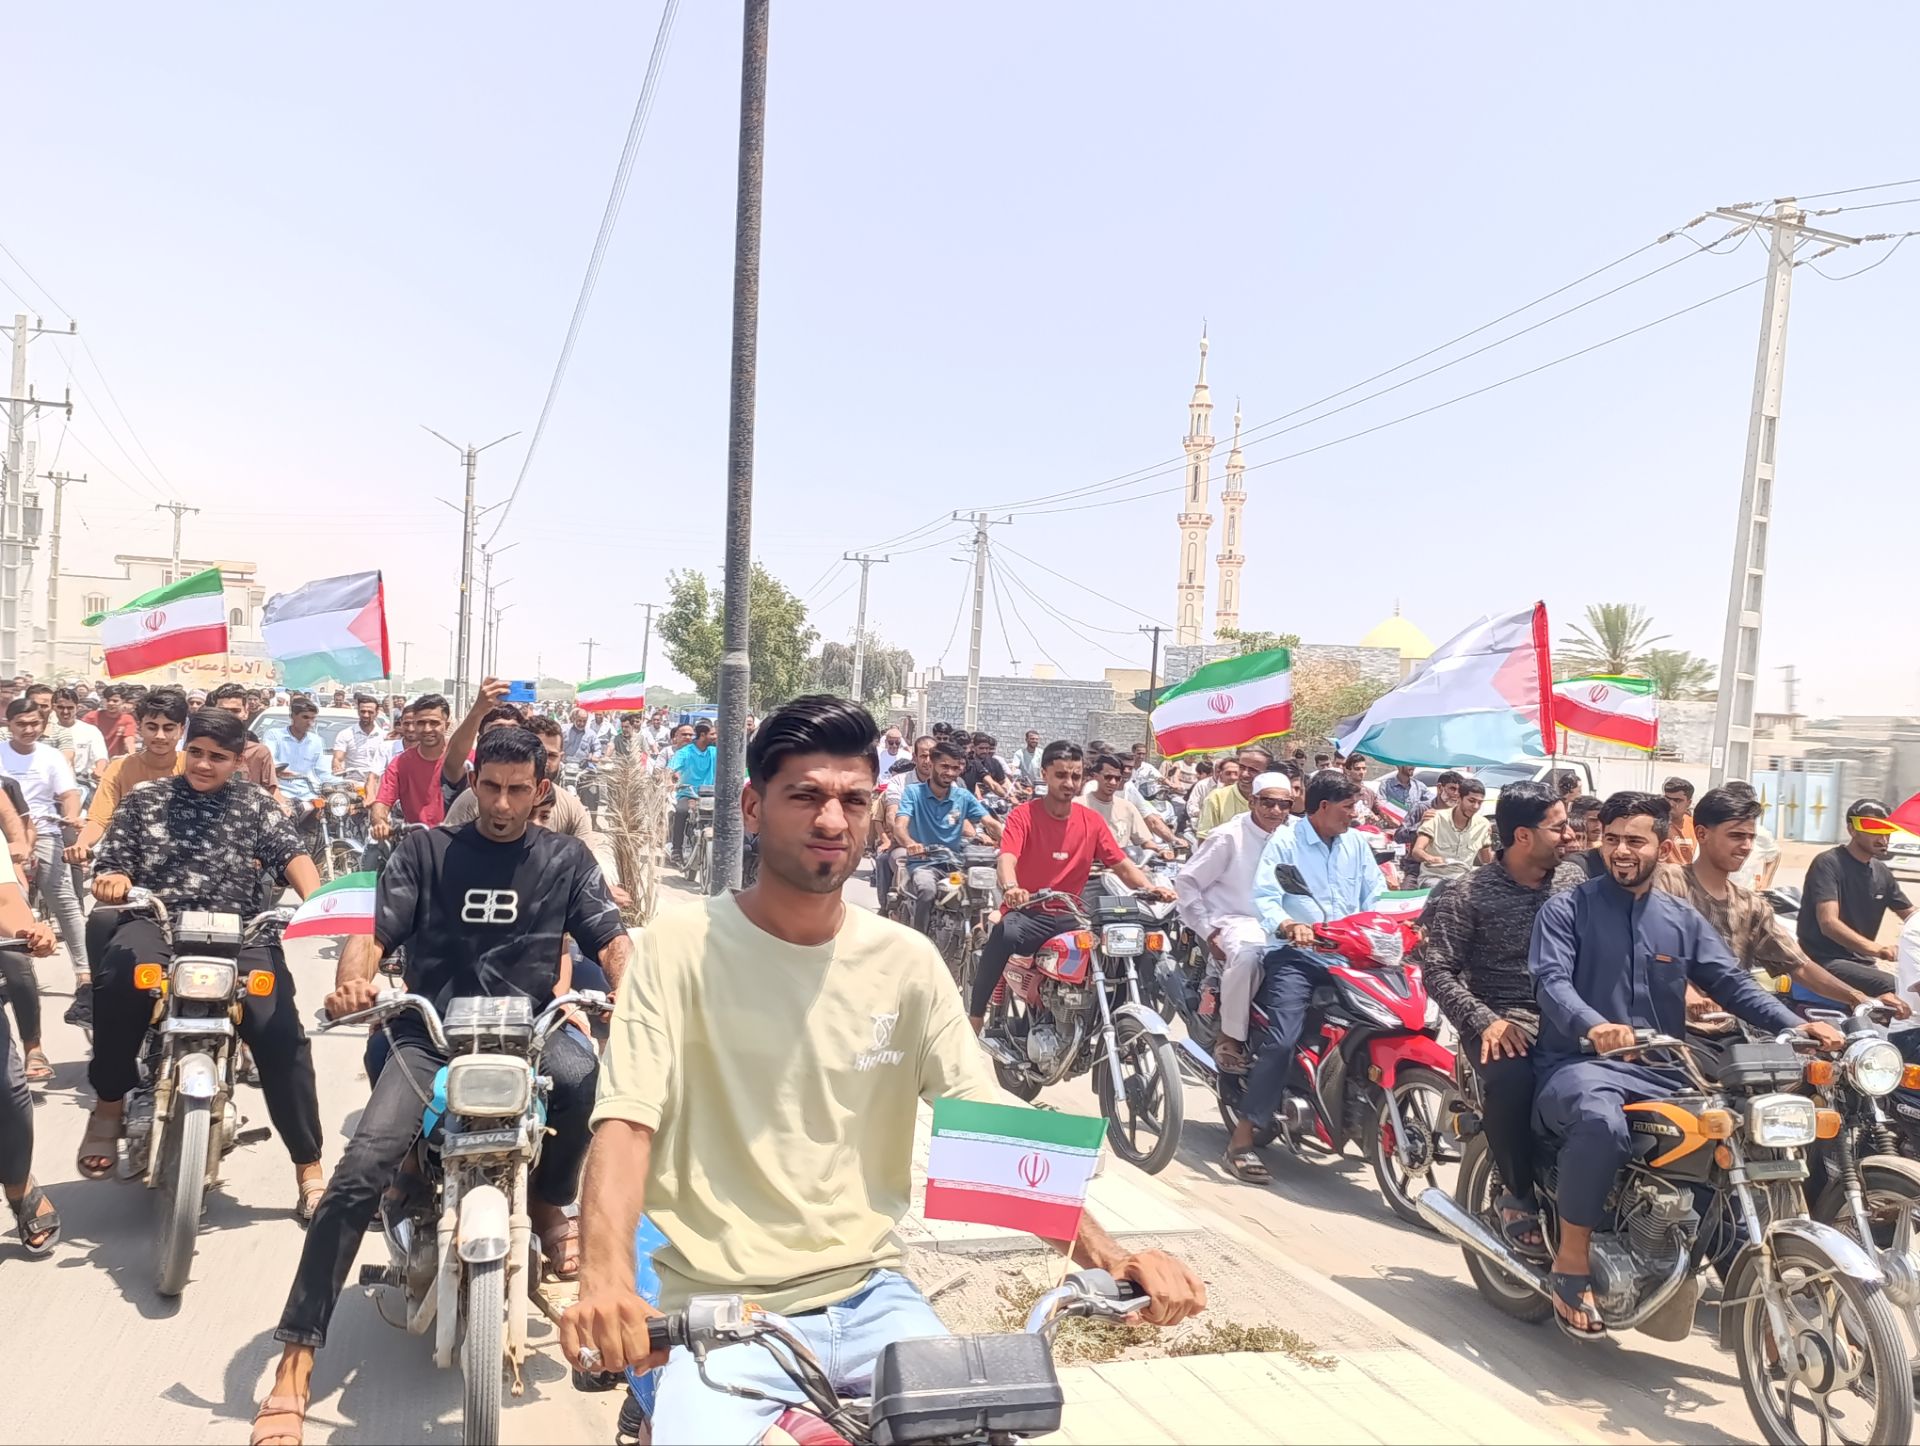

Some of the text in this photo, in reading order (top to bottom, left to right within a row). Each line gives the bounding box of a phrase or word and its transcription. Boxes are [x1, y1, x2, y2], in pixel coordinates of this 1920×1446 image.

[181, 658, 219, 674] مصالح
[219, 665, 228, 677] و
[230, 659, 263, 674] آلات
[455, 1131, 516, 1147] PARVAZ
